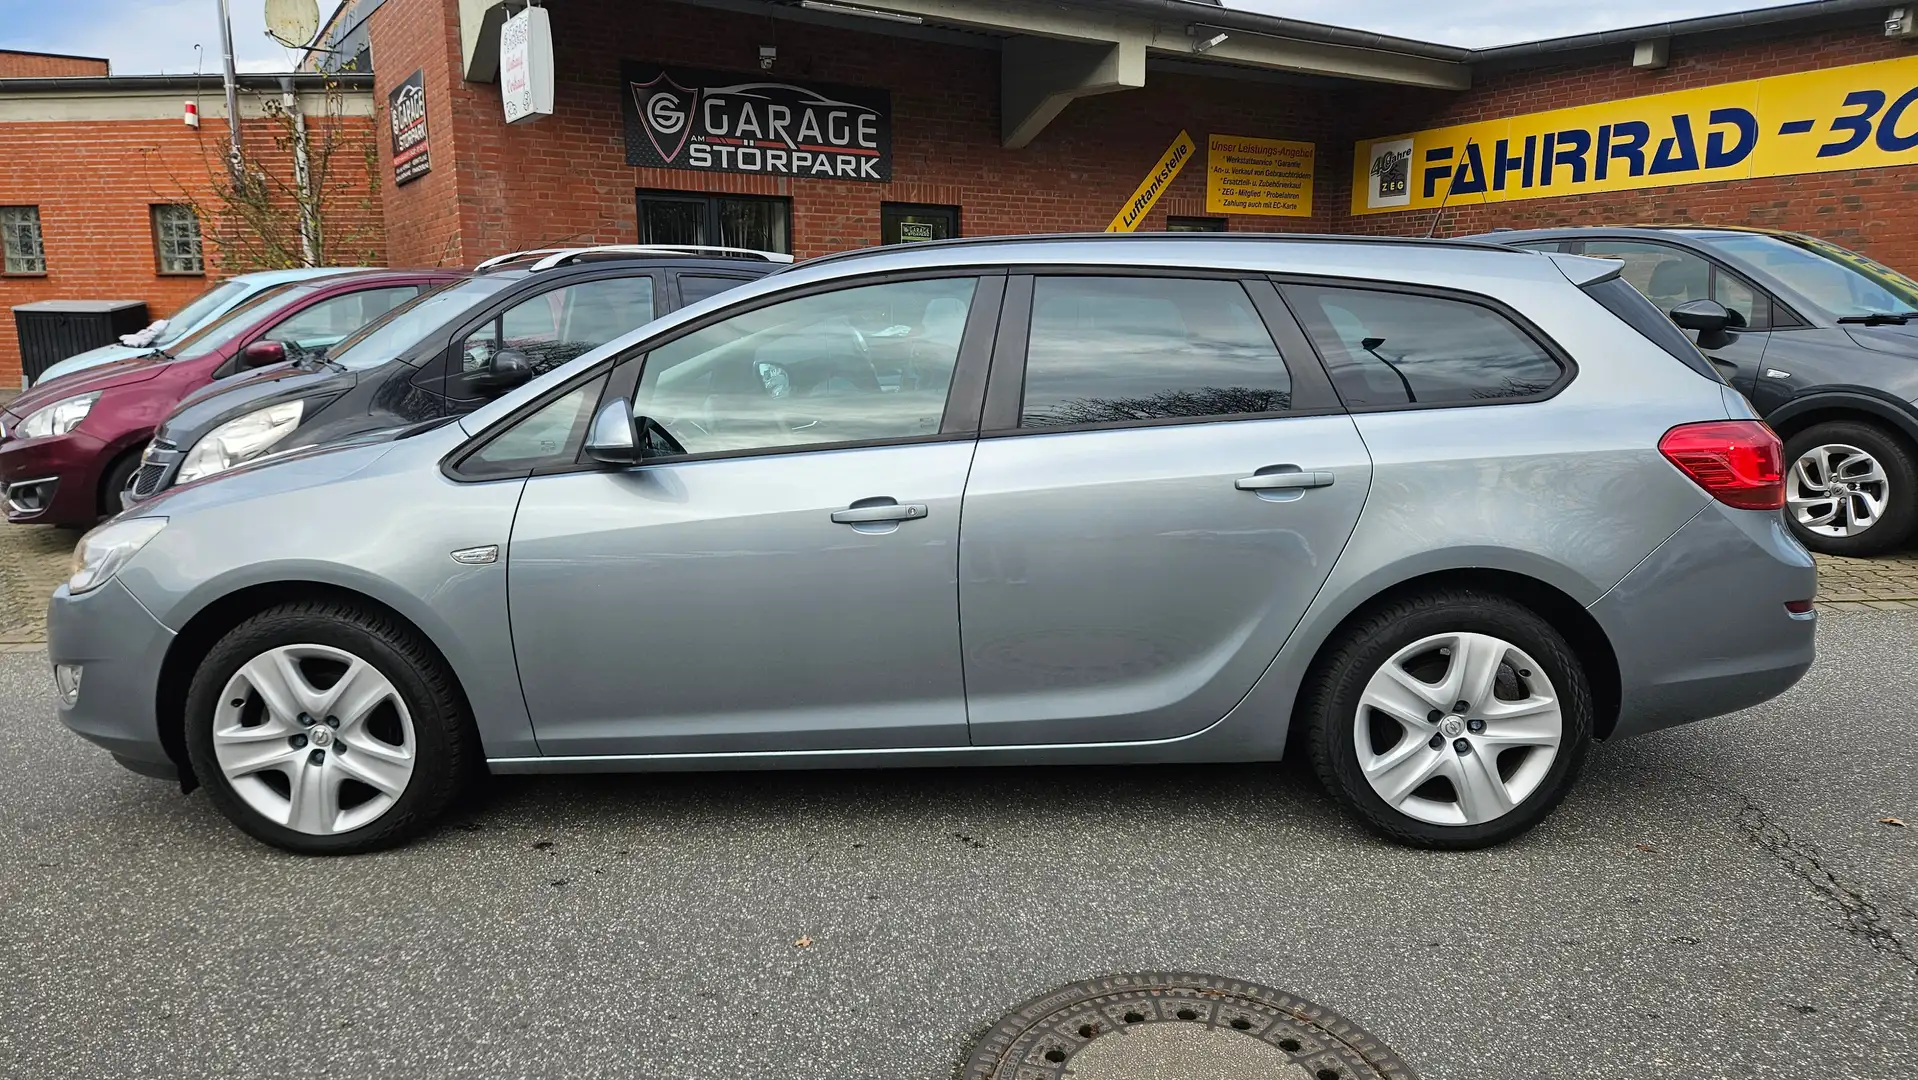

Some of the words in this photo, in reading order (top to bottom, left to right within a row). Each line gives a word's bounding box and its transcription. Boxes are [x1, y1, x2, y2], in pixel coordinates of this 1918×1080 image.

[704, 99, 877, 150] GARAGE
[1211, 141, 1236, 152] Unser
[1238, 144, 1313, 158] Leistungs-Angebot
[1423, 107, 1759, 197] FAHRRAD
[689, 139, 881, 179] STÖRPARK
[1231, 167, 1254, 175] Verkauf
[1122, 144, 1187, 228] Lufttankstelle
[1221, 188, 1234, 196] ZEG
[1238, 188, 1261, 199] Mitglied
[1266, 190, 1300, 199] Probefahren
[1381, 181, 1404, 192] ZEG
[1223, 199, 1247, 209] Zahlung
[1272, 202, 1297, 210] EC-Karte
